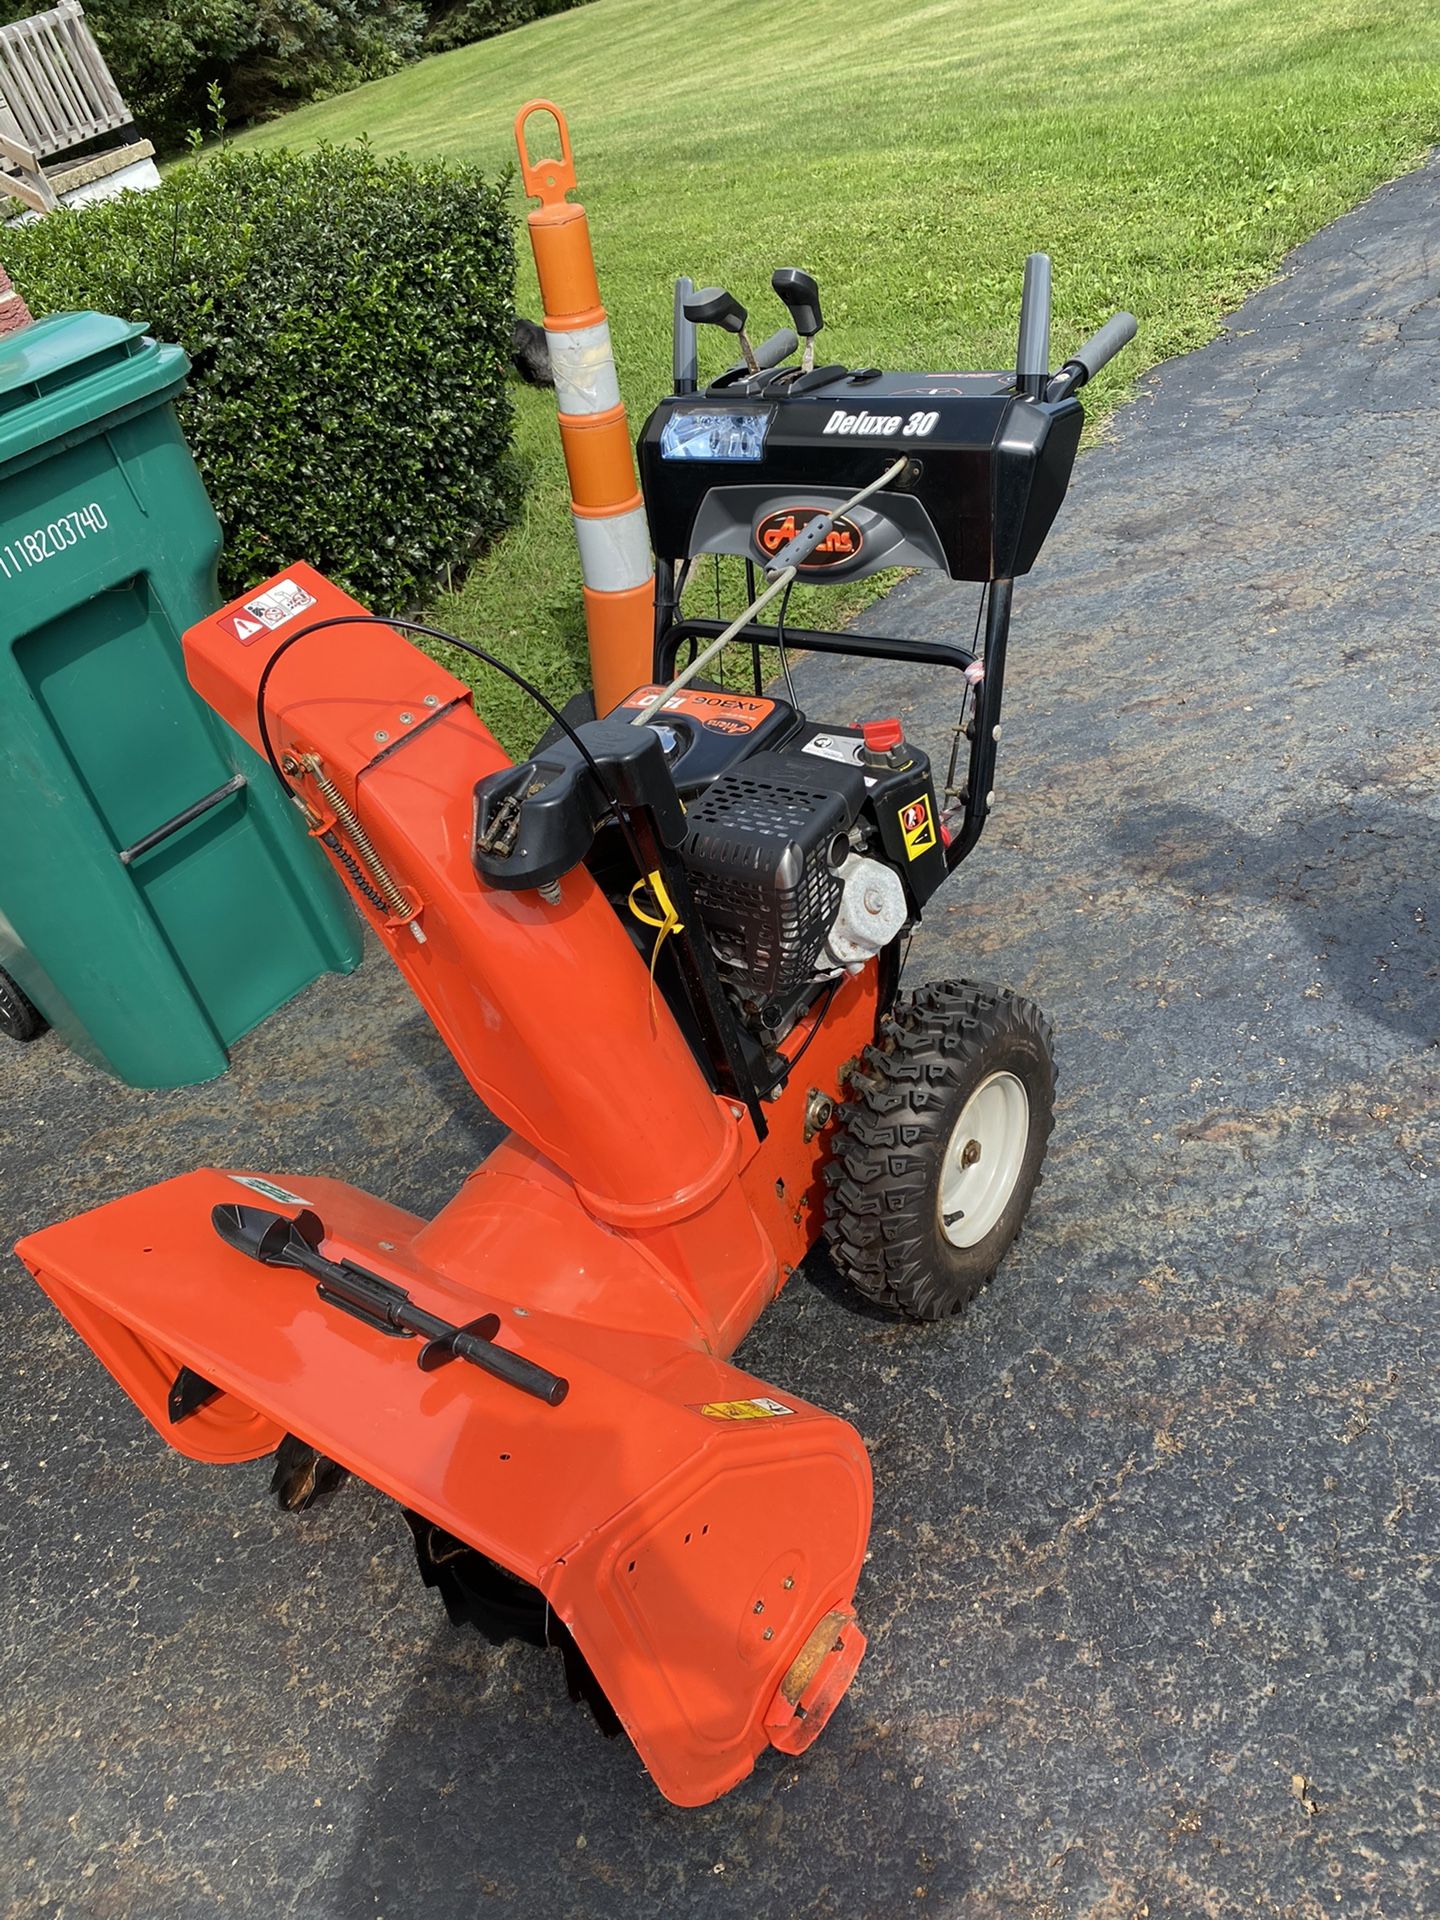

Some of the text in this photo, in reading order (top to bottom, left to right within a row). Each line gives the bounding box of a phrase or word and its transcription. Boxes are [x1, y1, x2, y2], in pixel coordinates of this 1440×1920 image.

[823, 411, 940, 437] Deluxe 30
[691, 696, 764, 711] AX306
[707, 718, 752, 734] Ariens
